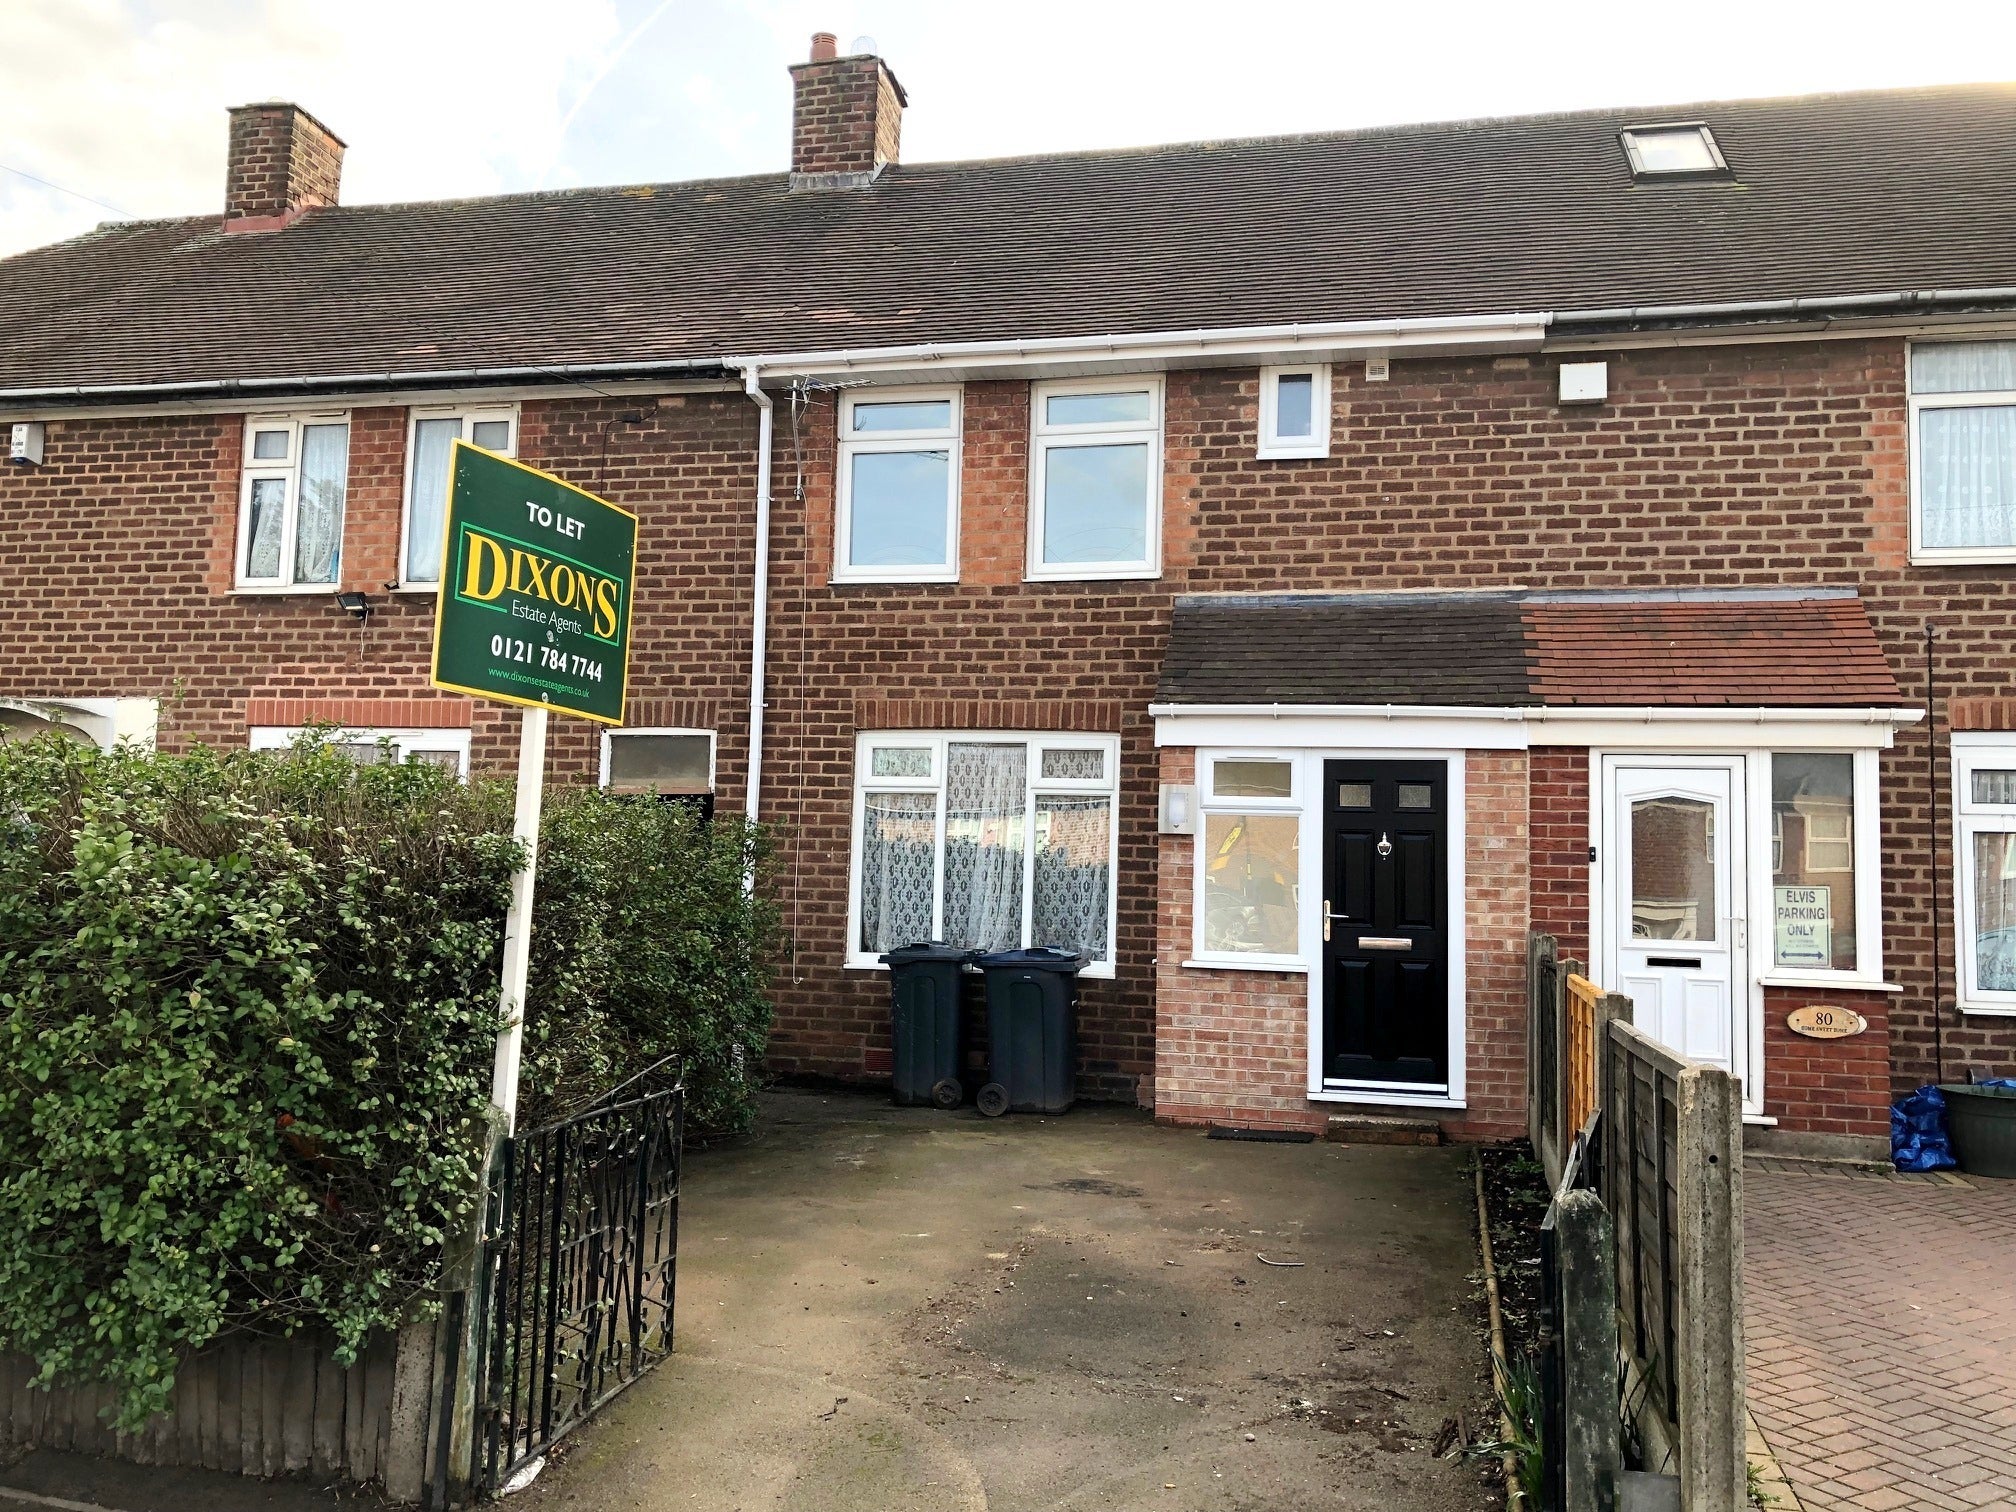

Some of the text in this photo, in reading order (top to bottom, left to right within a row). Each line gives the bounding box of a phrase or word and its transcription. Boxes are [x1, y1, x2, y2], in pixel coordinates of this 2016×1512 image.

[526, 501, 585, 540] TO LET
[460, 531, 617, 638] DIXONS
[512, 600, 582, 634] Estate Agents
[491, 634, 602, 682] 0121 784 7744
[488, 668, 590, 697] www.dixonsestateagents.co.uk
[1786, 890, 1816, 903] ELVIS
[1778, 907, 1825, 920] PARKING
[1787, 924, 1815, 936] ONLY
[1816, 1012, 1833, 1025] 80
